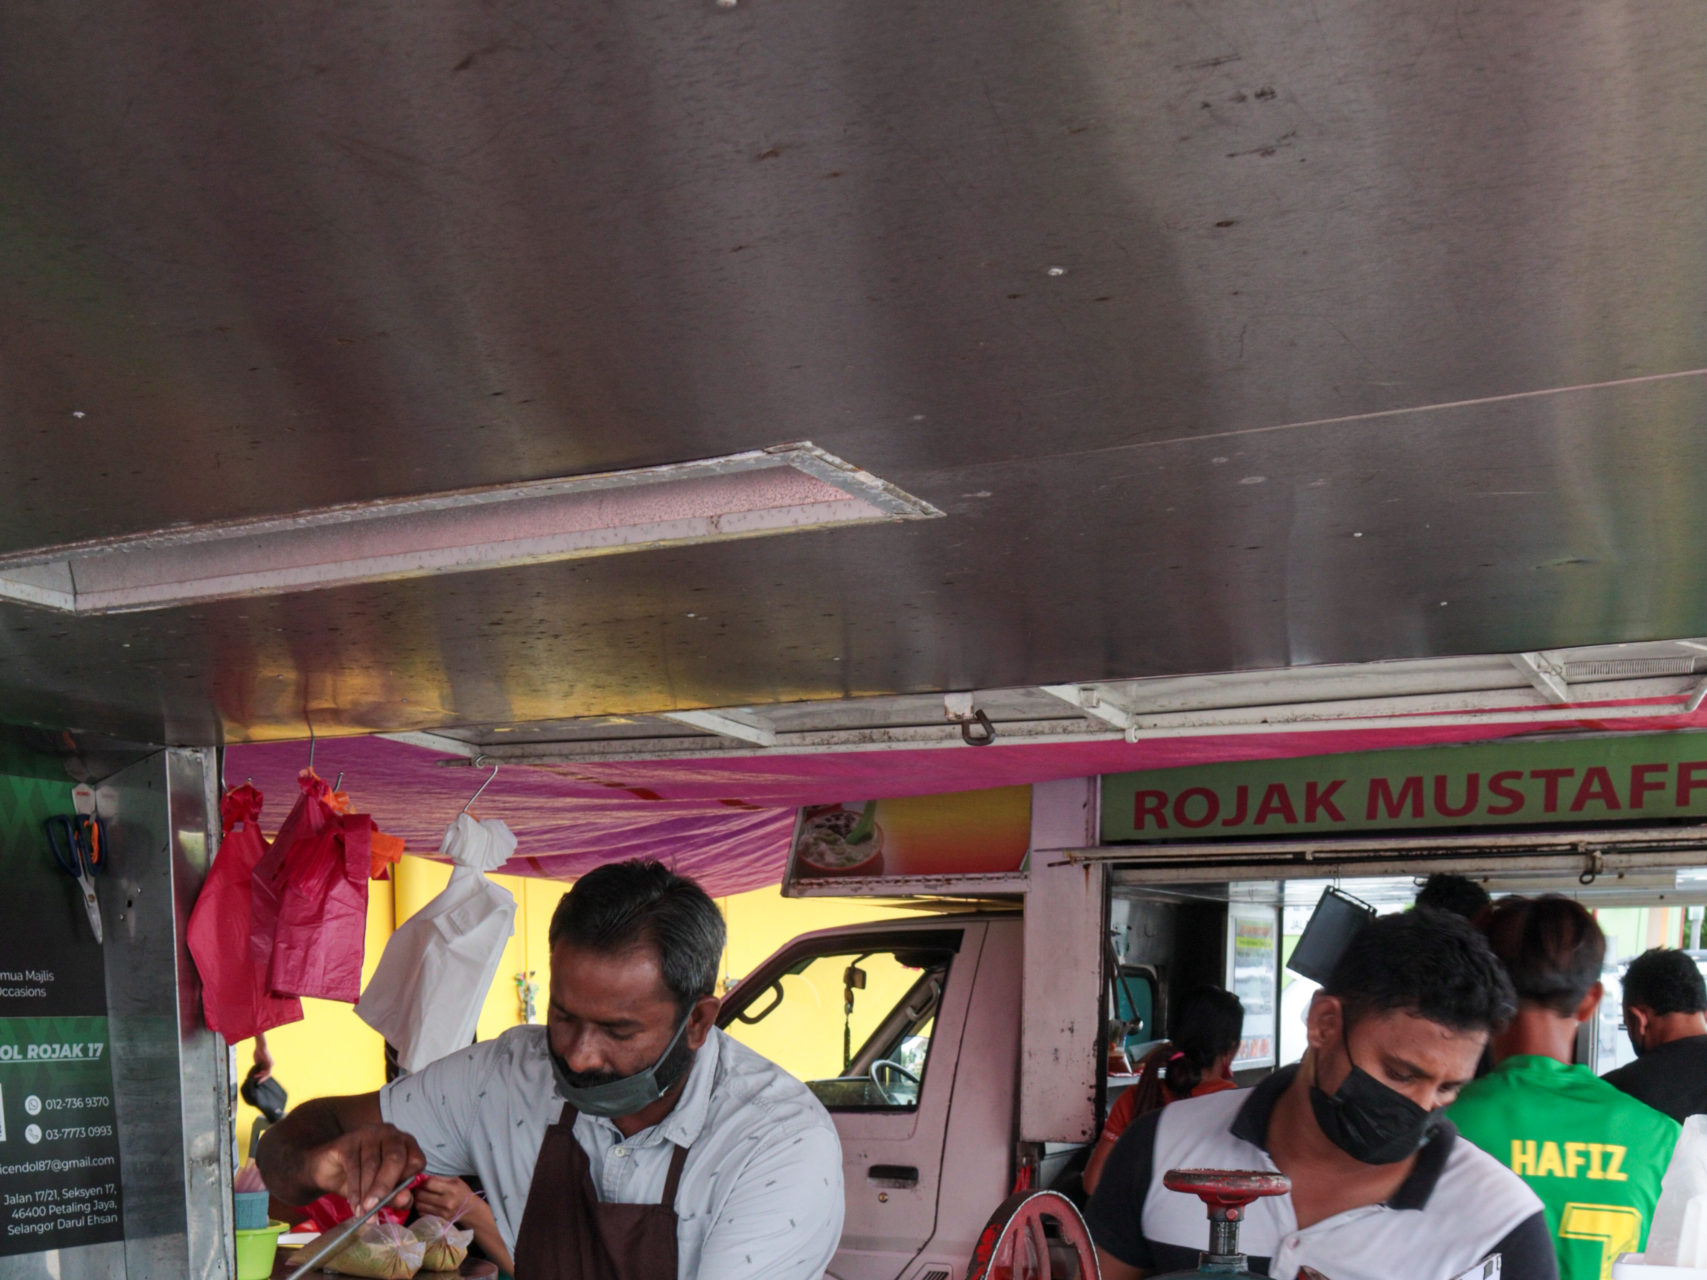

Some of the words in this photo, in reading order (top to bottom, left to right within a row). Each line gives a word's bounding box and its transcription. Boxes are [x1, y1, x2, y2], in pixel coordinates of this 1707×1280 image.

[1133, 779, 1346, 831] ROJAK
[25, 970, 55, 983] Majlis
[27, 1043, 84, 1059] ROJAK
[88, 1042, 104, 1057] 17
[45, 1097, 84, 1110] 012-736
[86, 1096, 110, 1108] 9370
[45, 1127, 86, 1140] 03-7773
[88, 1125, 112, 1137] 0993
[1511, 1139, 1628, 1182] HAFIZ
[4, 1193, 32, 1206] Jalan
[35, 1189, 60, 1202] 17/21,
[62, 1186, 103, 1199] Seksyen
[105, 1183, 117, 1195] 17,
[11, 1206, 46, 1220] 46400
[49, 1202, 91, 1216] Petaling
[93, 1200, 118, 1213] Jaya,
[8, 1220, 54, 1236] Selangor
[57, 1217, 85, 1230] Darul
[87, 1214, 118, 1226] Ehsan
